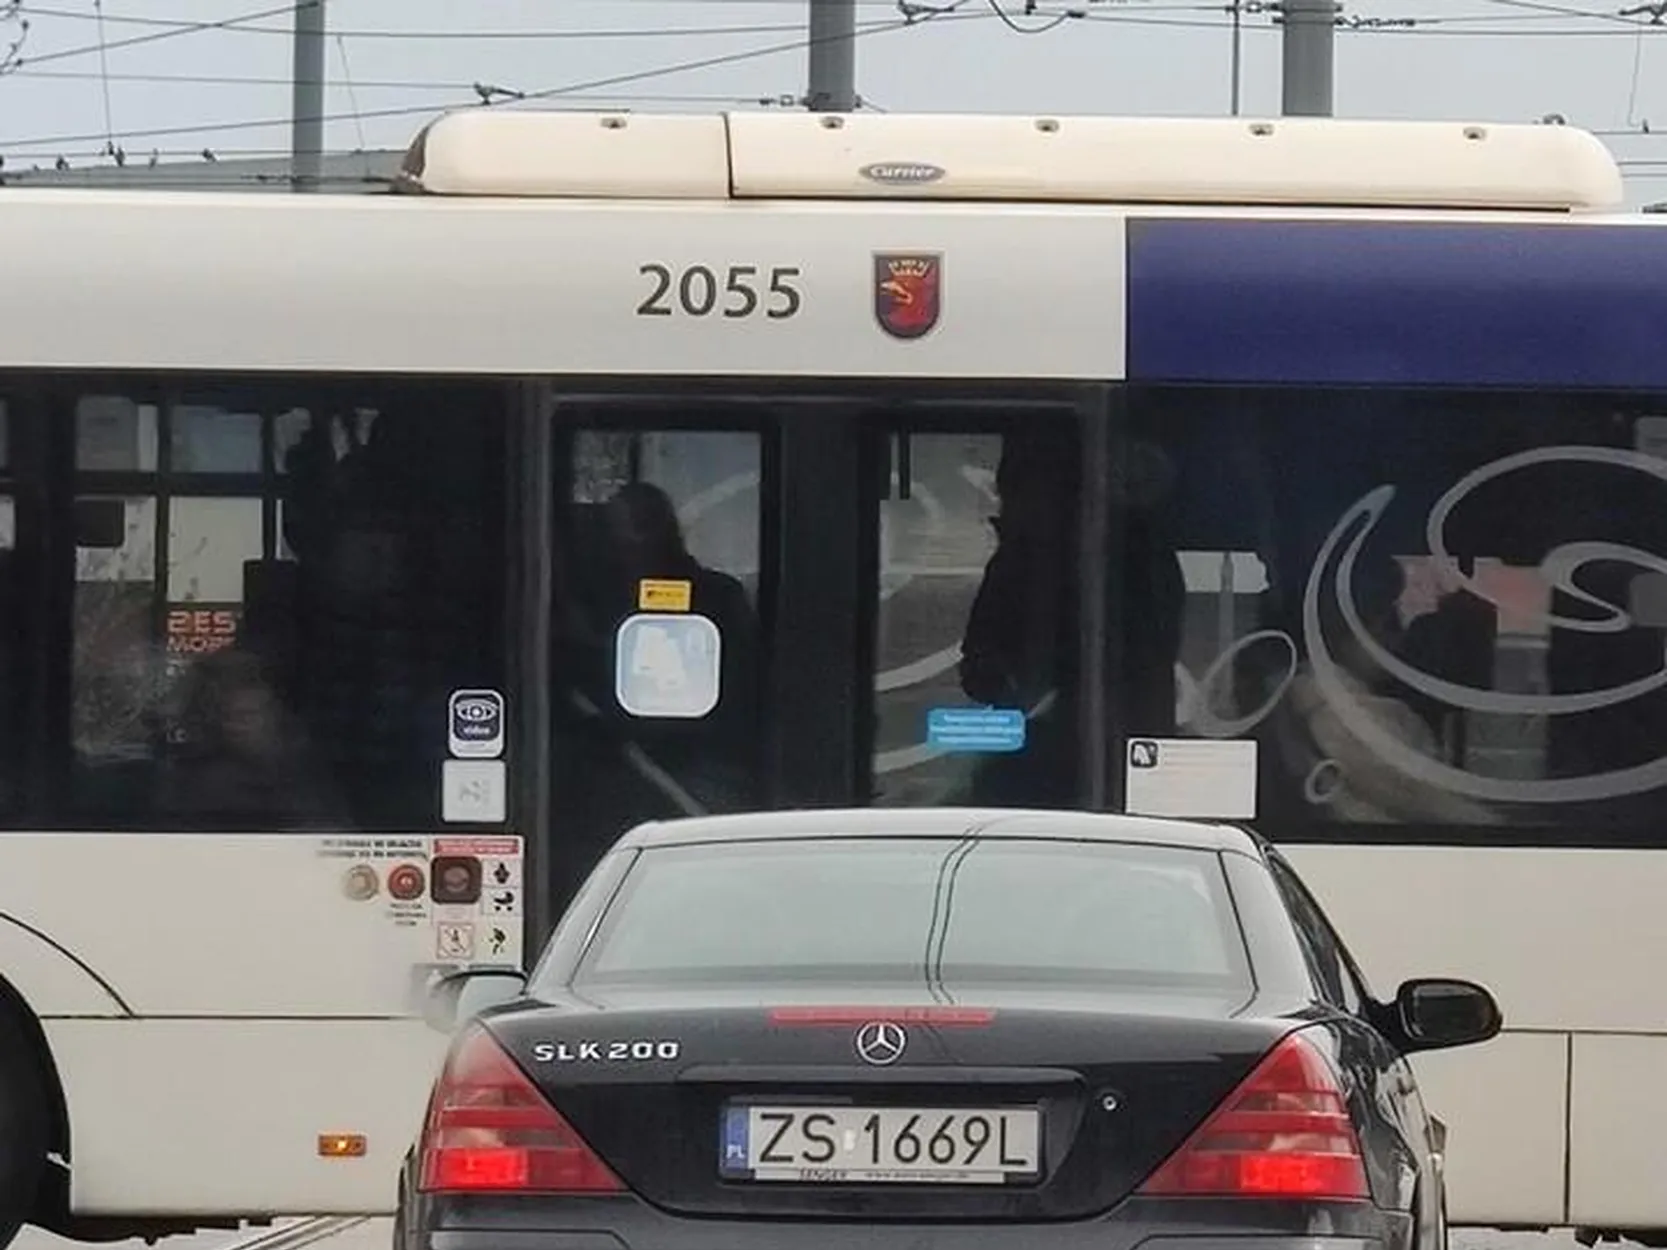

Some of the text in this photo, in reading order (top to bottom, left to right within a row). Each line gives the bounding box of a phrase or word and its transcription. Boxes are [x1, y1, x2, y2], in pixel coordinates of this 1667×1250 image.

[636, 264, 801, 319] 2055
[534, 1042, 679, 1062] SLK 200
[726, 1145, 745, 1159] PL
[759, 1113, 1028, 1166] ZS 1669L
